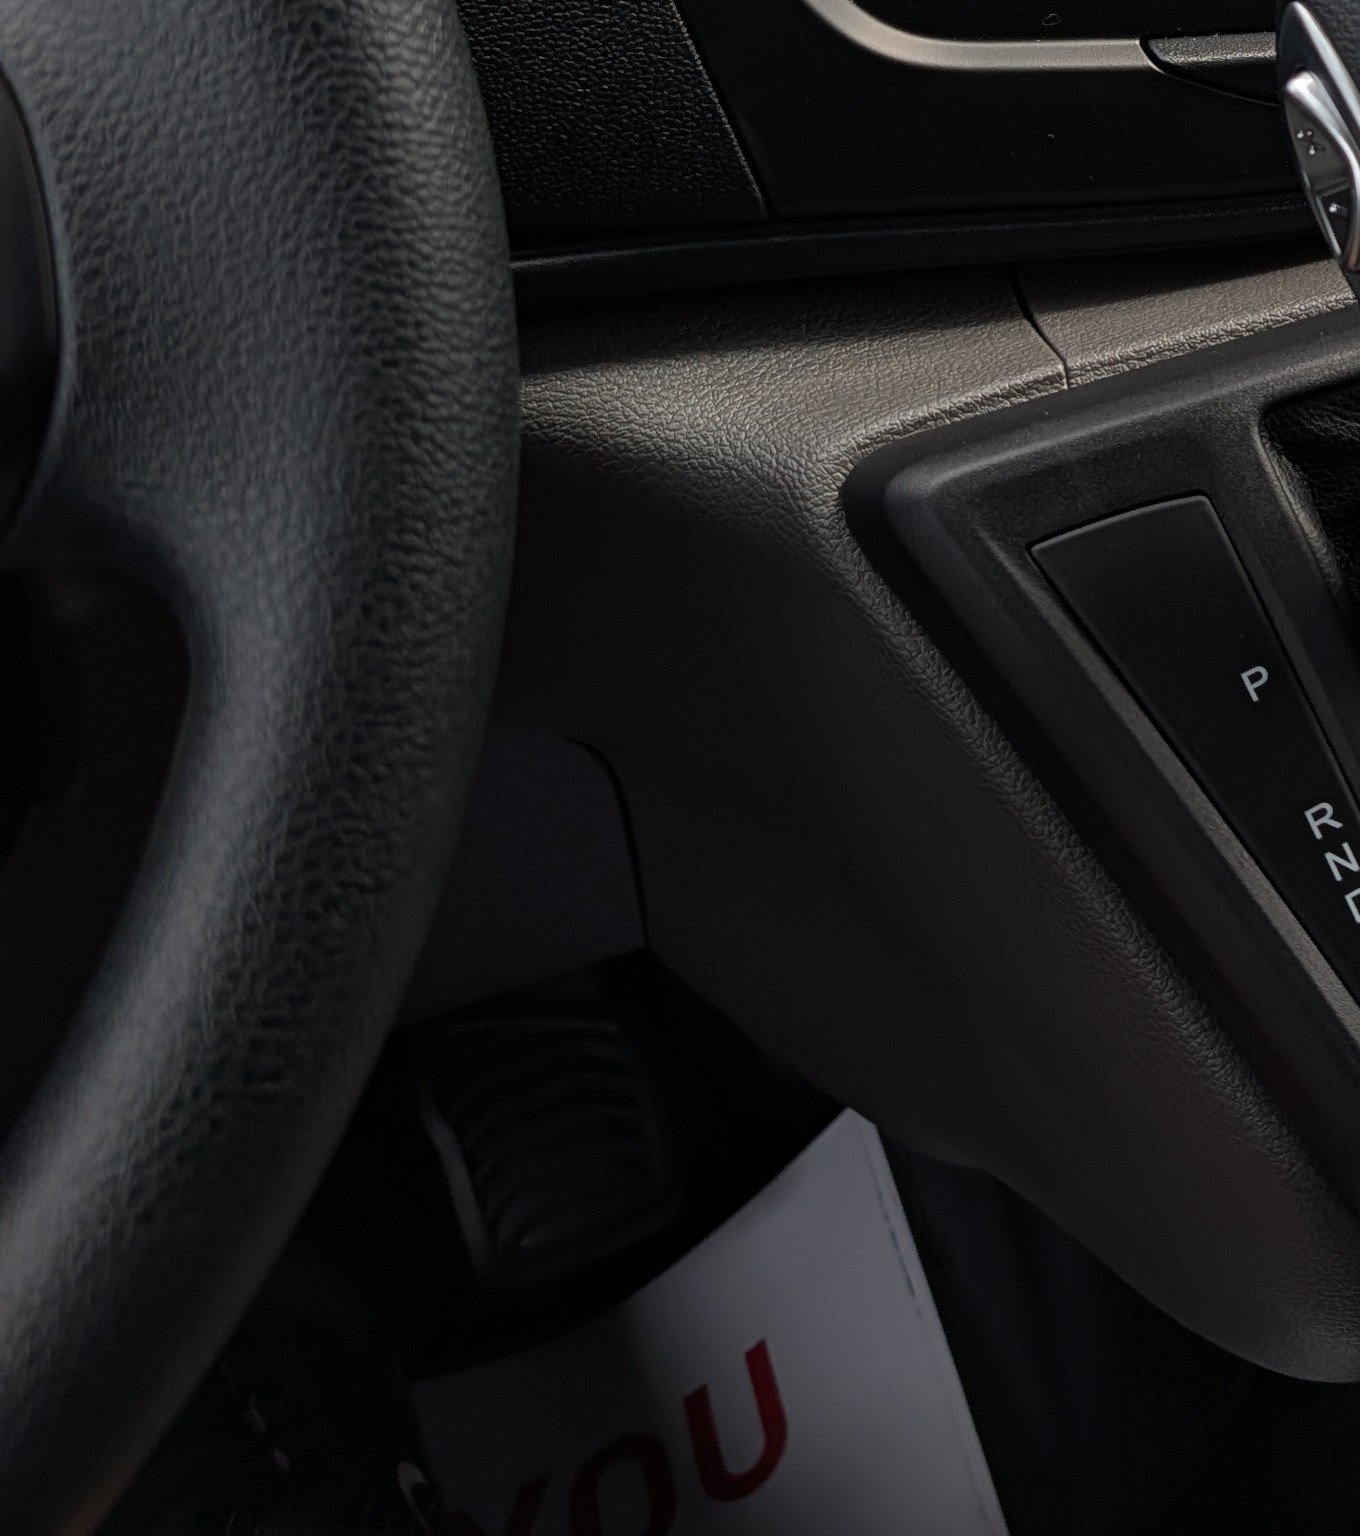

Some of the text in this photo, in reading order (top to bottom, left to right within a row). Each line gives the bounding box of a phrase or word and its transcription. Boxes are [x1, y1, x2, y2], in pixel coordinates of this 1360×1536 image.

[1240, 665, 1269, 703] P
[1304, 802, 1343, 840] R
[1324, 842, 1360, 882] N
